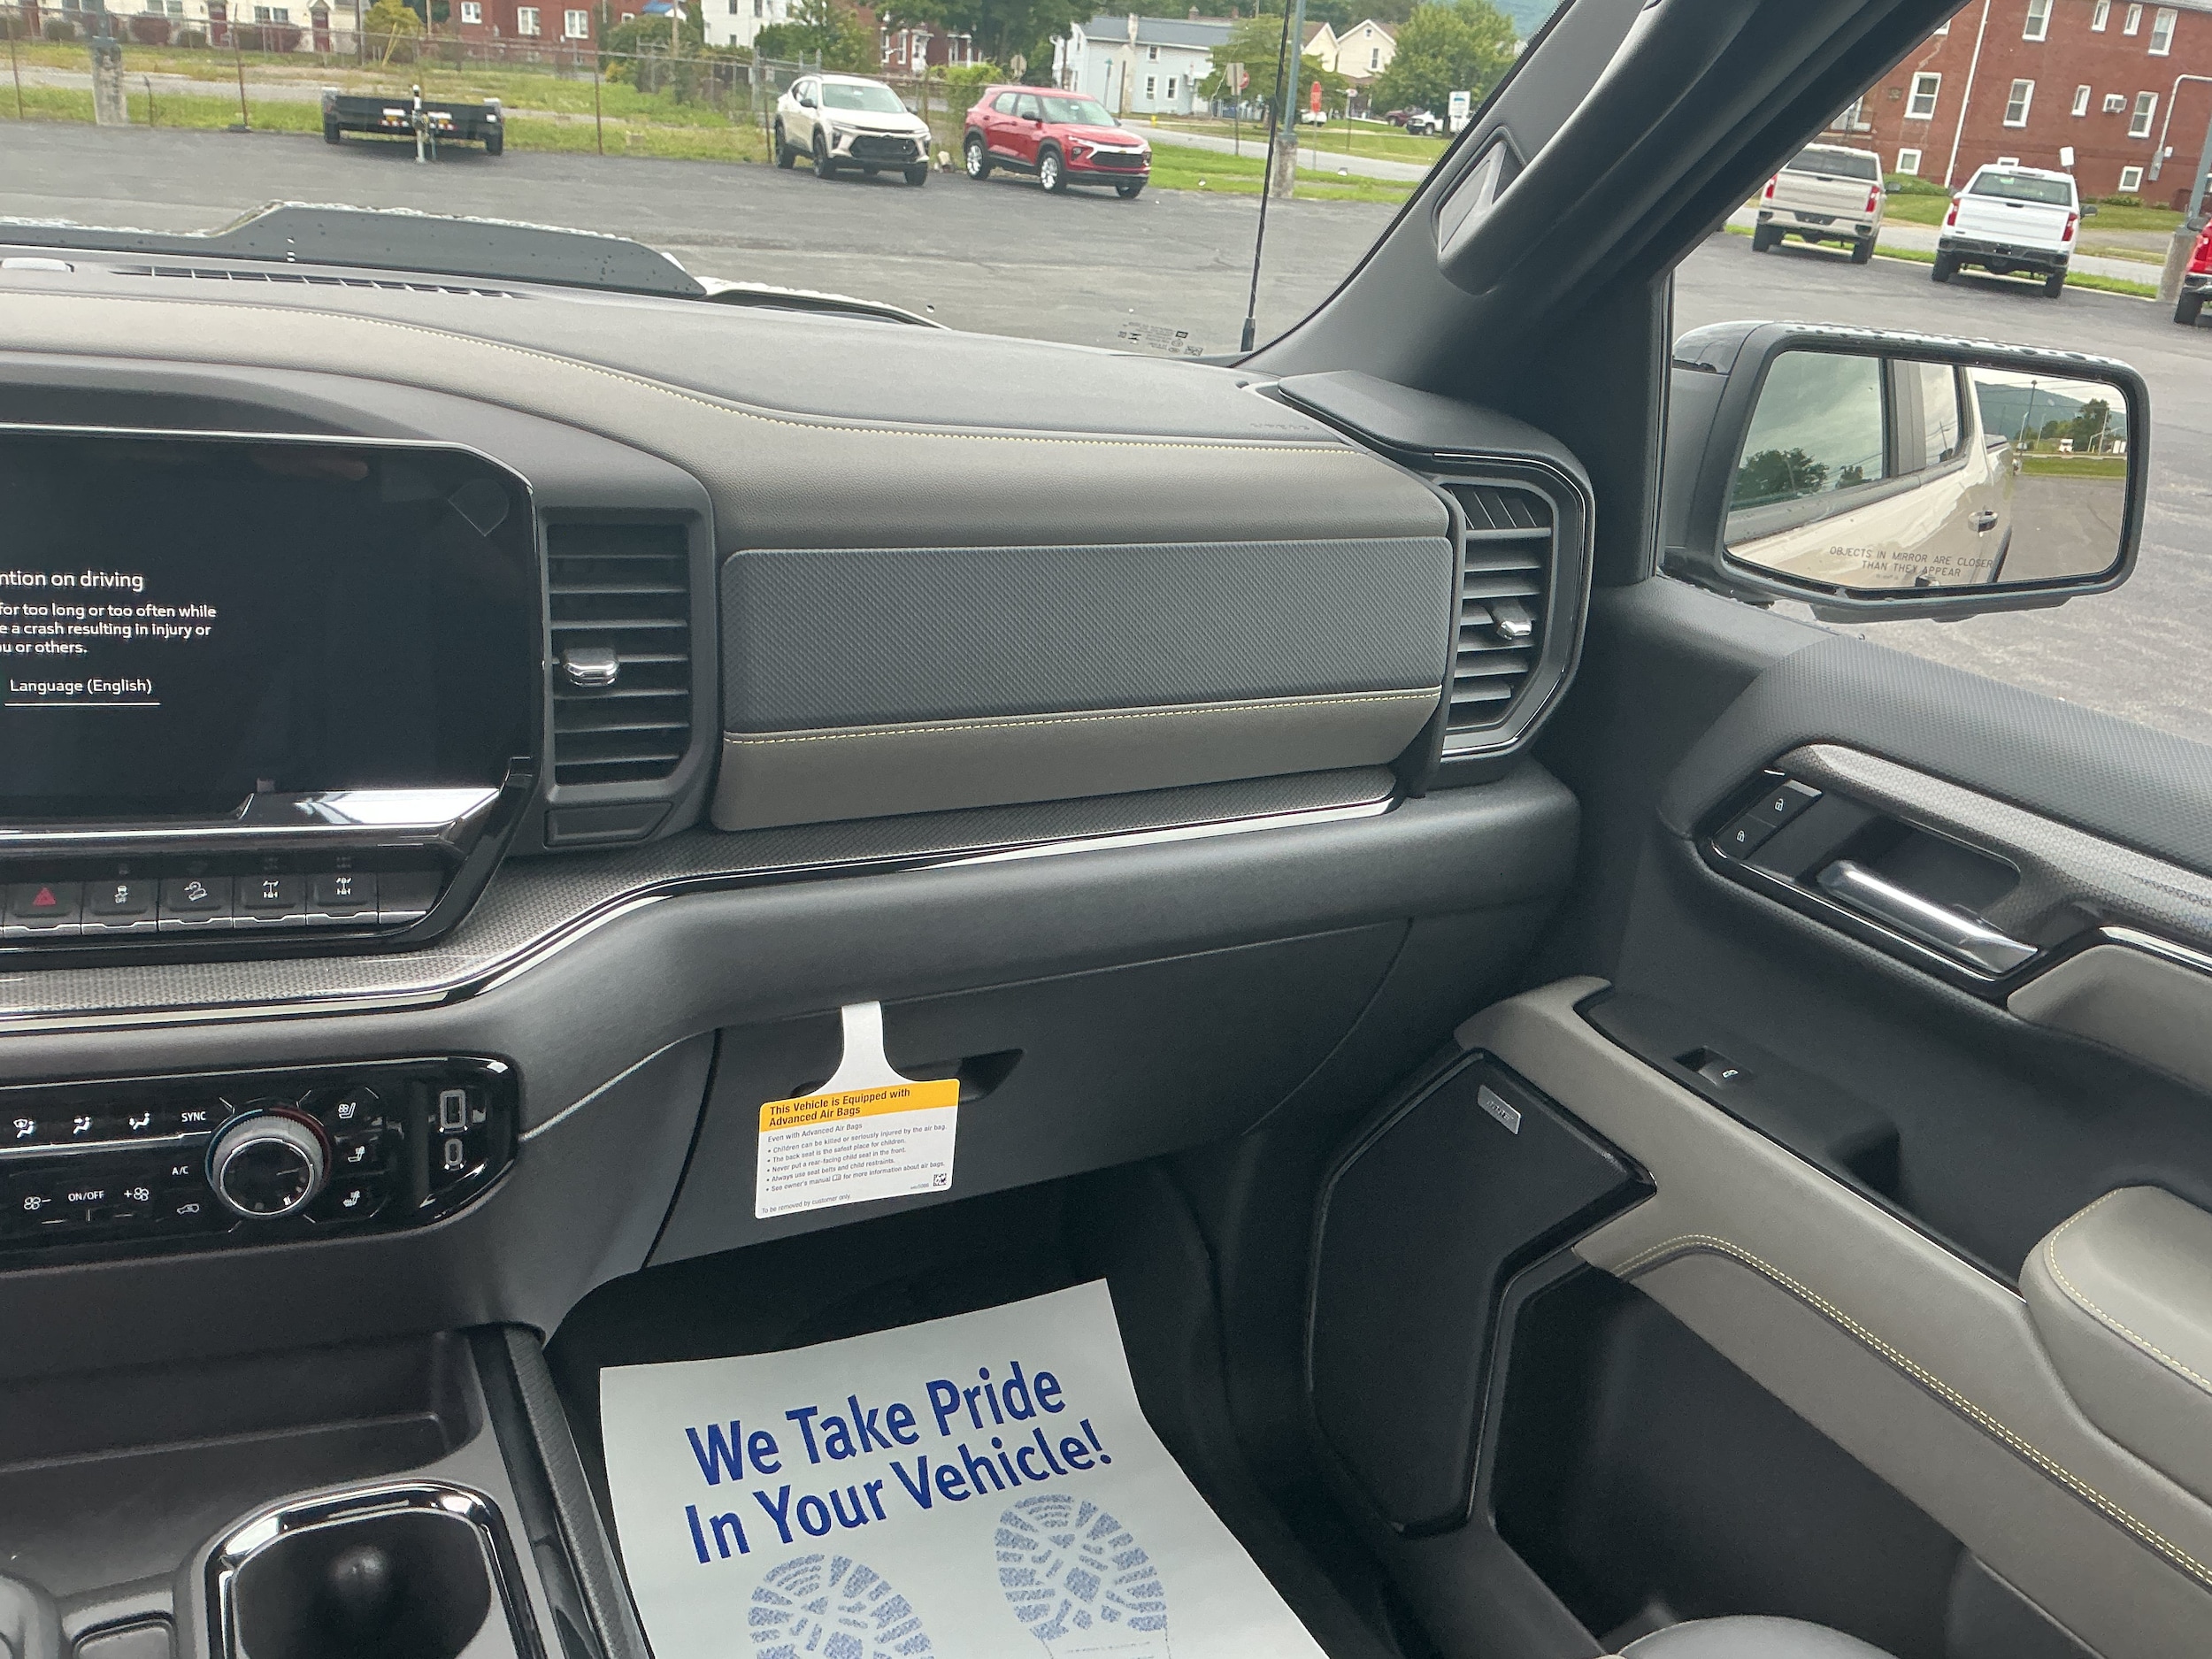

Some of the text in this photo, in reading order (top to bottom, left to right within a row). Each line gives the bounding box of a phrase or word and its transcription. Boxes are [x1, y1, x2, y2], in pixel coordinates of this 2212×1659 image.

[1829, 546, 1993, 569] OBJECTS IN MIRROR ARE CLOSER
[1862, 560, 1962, 577] THAN THEY APPEAR
[50, 572, 75, 588] on
[80, 571, 143, 591] driving
[0, 603, 217, 619] for too long or too often while
[11, 625, 21, 634] a
[24, 622, 64, 635] crash
[67, 622, 133, 638] resulting
[135, 623, 149, 636] in
[152, 623, 192, 639] injury
[196, 626, 211, 636] or
[15, 643, 33, 654] or
[35, 641, 88, 654] others.
[10, 678, 152, 695] Language (English)
[770, 1087, 910, 1116] This Vehicle is Equipped with
[181, 1111, 207, 1123] SYNC
[769, 1106, 861, 1127] Advanced Air Bags
[786, 1131, 800, 1140] with
[802, 1126, 833, 1137] Advanced
[847, 1123, 863, 1132] Bags
[772, 1144, 800, 1154] Children
[851, 1132, 879, 1141] seriously
[853, 1142, 870, 1151] place
[172, 1164, 189, 1177] A/C
[772, 1164, 790, 1173] Never
[808, 1156, 841, 1167] rear-facing
[772, 1172, 794, 1182] Always
[822, 1165, 836, 1174] belts
[784, 1180, 808, 1189] owner's
[809, 1176, 831, 1186] manual
[869, 1166, 902, 1176] information
[67, 1189, 105, 1202] ON/OFF
[778, 1201, 803, 1211] removed
[811, 1194, 838, 1205] customer
[685, 1360, 1067, 1486] We Take Pride
[683, 1417, 1113, 1564] In Your Vehicle!
